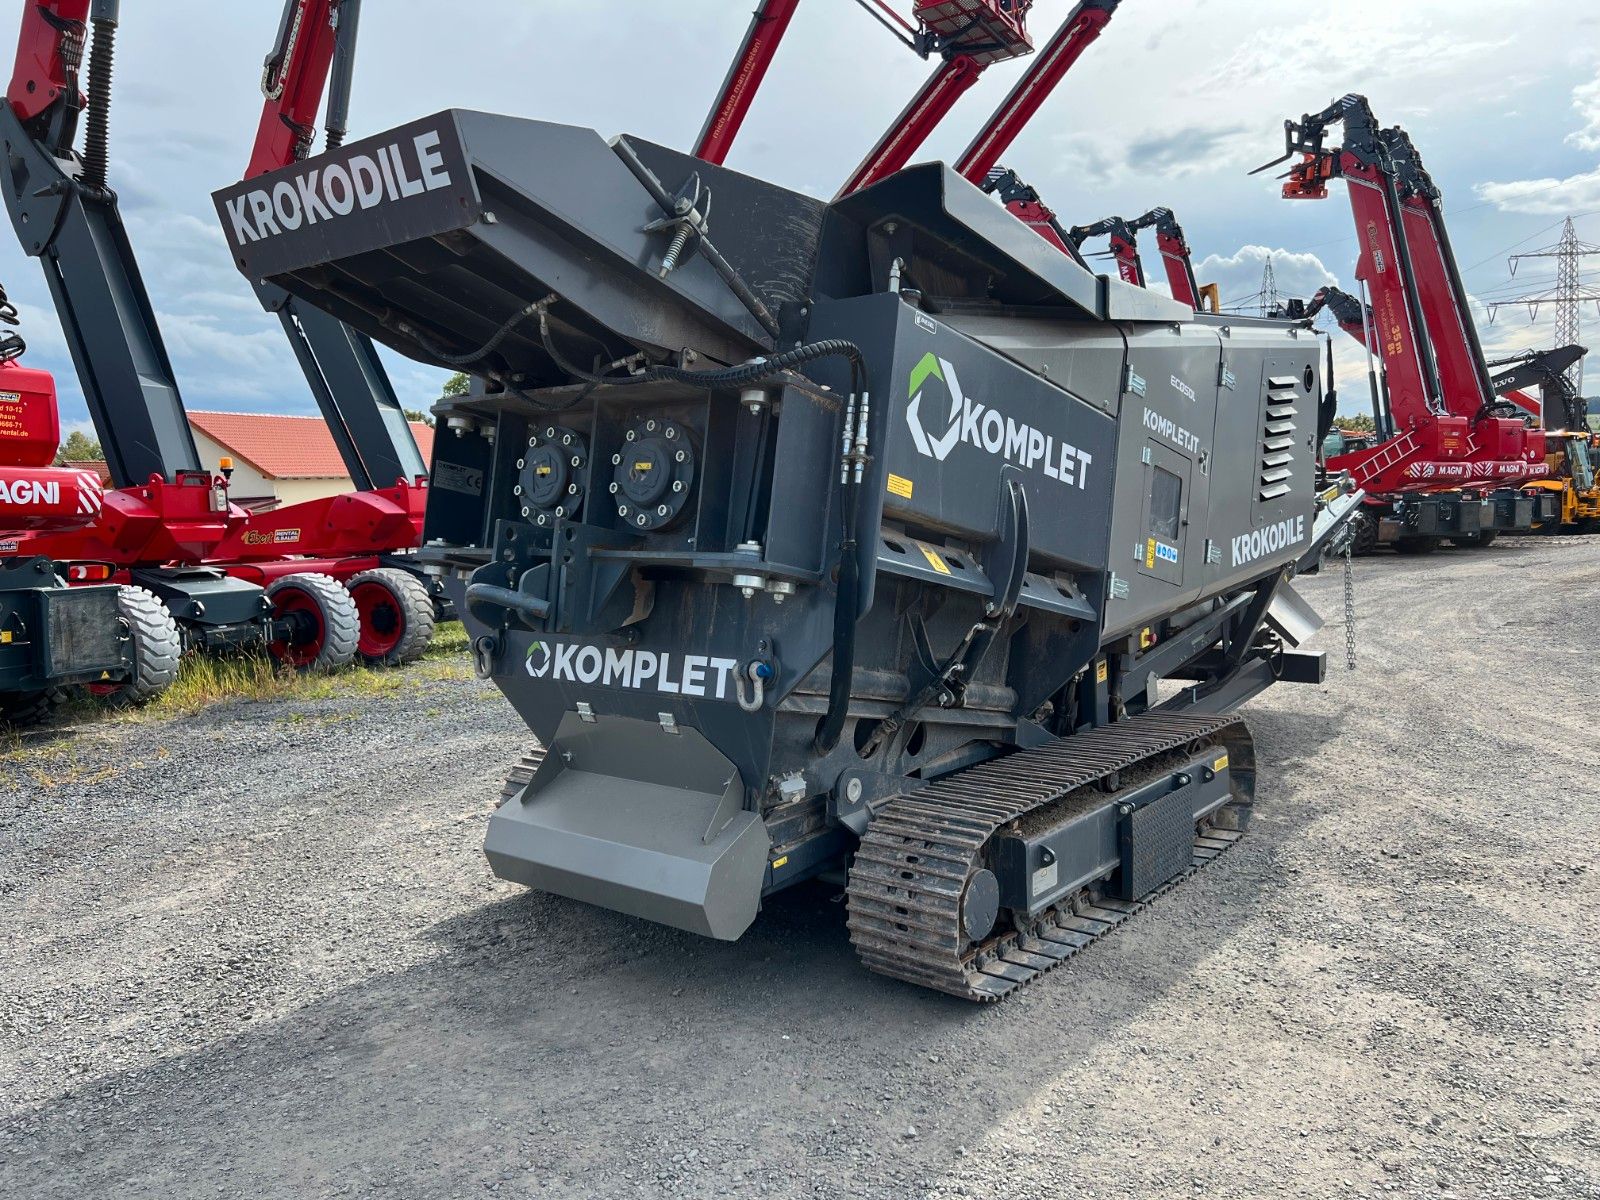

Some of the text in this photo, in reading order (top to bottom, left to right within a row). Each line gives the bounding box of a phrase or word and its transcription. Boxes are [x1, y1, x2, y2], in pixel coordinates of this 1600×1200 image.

[712, 116, 726, 138] mich
[723, 94, 737, 117] kann
[734, 73, 746, 94] man
[225, 130, 451, 246] KROKODILE
[1493, 376, 1515, 388] LVO
[960, 396, 1092, 490] KOMPLET
[1143, 406, 1200, 454] KOMPLET.IT
[1439, 466, 1463, 475] MAGNI
[1499, 465, 1519, 474] MAGNI
[1231, 514, 1304, 568] KROKODILE
[553, 643, 737, 699] KOMPLET
